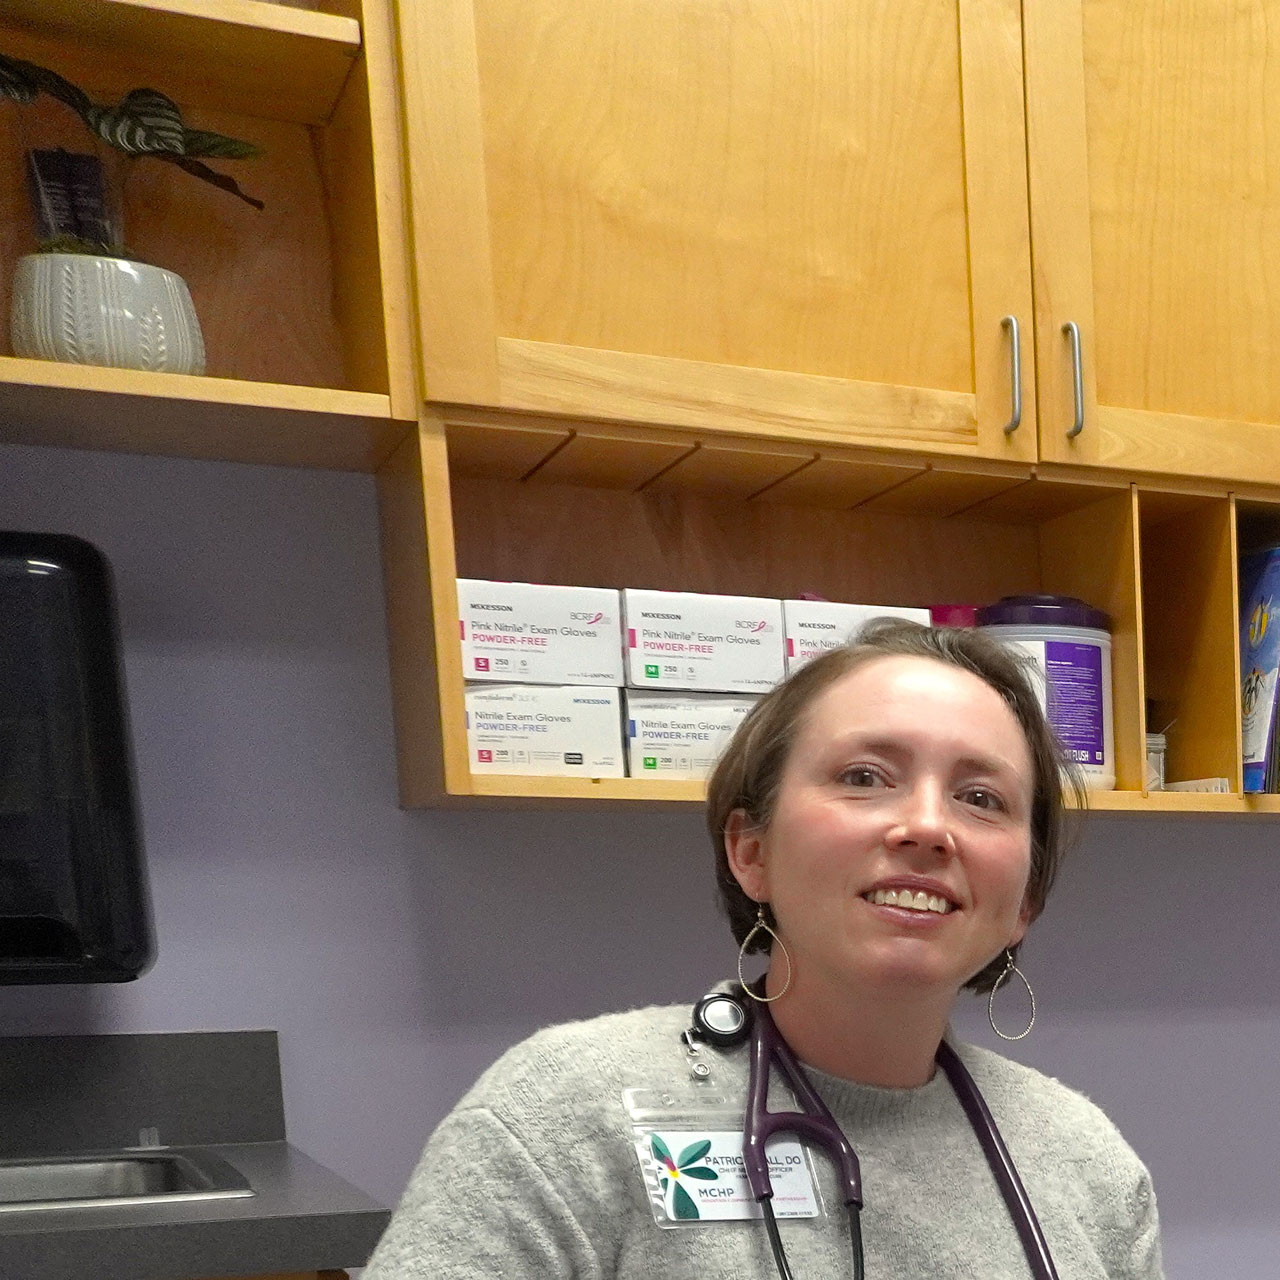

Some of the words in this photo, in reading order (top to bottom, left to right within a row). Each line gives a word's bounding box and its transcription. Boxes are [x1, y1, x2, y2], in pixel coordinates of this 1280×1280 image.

[471, 621, 492, 631] Pink
[531, 626, 557, 635] Exam
[561, 627, 597, 638] Gloves
[472, 634, 548, 646] POWDER-FREE
[642, 629, 662, 639] Pink
[698, 633, 723, 643] Exam
[726, 635, 761, 645] Gloves
[643, 641, 714, 653] POWDER-FREE
[799, 639, 818, 648] Pink
[495, 658, 509, 666] 250
[475, 711, 504, 720] Nitrile
[506, 712, 533, 721] Exam
[535, 713, 571, 723] Gloves
[476, 722, 548, 732] POWDER-FREE
[641, 720, 668, 729] Nitrile
[671, 721, 695, 730] Exam
[698, 722, 732, 731] Gloves
[642, 732, 710, 741] POWDER-FREE
[1072, 750, 1089, 761] FLUSH
[786, 1156, 801, 1165] DO
[698, 1188, 734, 1197] MCHP
